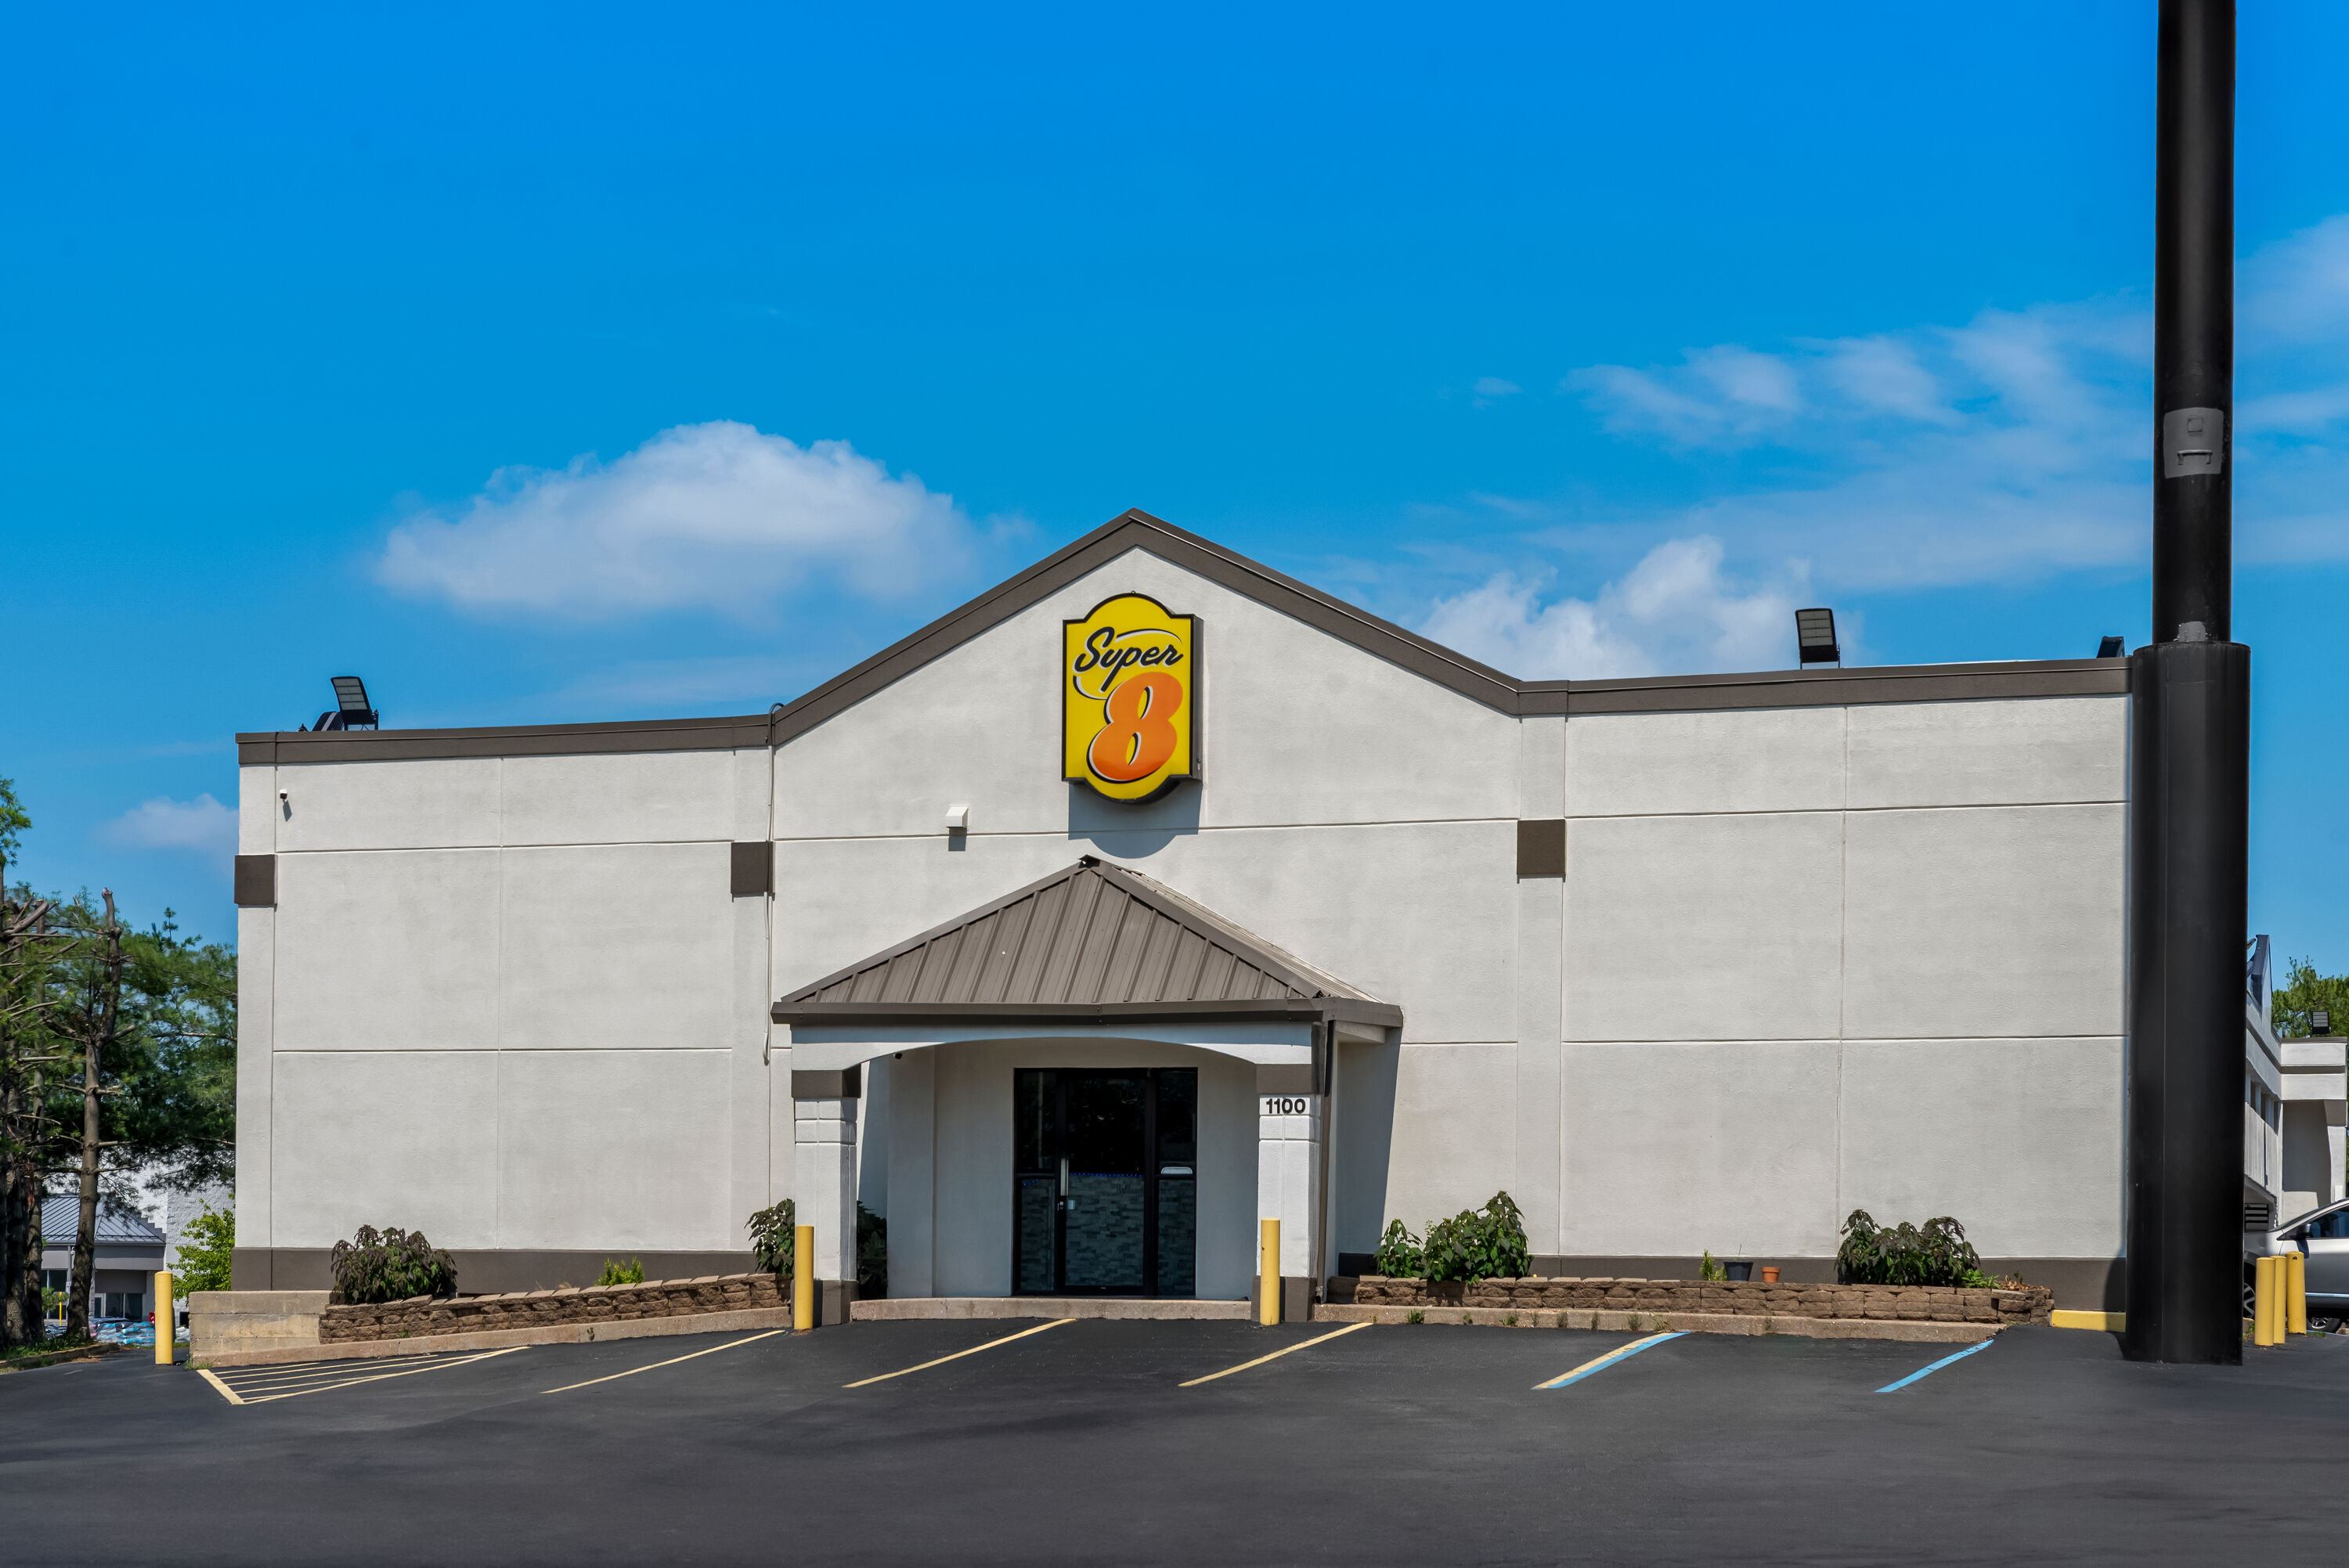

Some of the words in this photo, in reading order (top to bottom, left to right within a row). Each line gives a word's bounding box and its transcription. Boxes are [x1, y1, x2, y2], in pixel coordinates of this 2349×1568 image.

[1073, 626, 1184, 693] Super
[1086, 672, 1183, 784] 8
[1266, 1098, 1306, 1115] 1100
